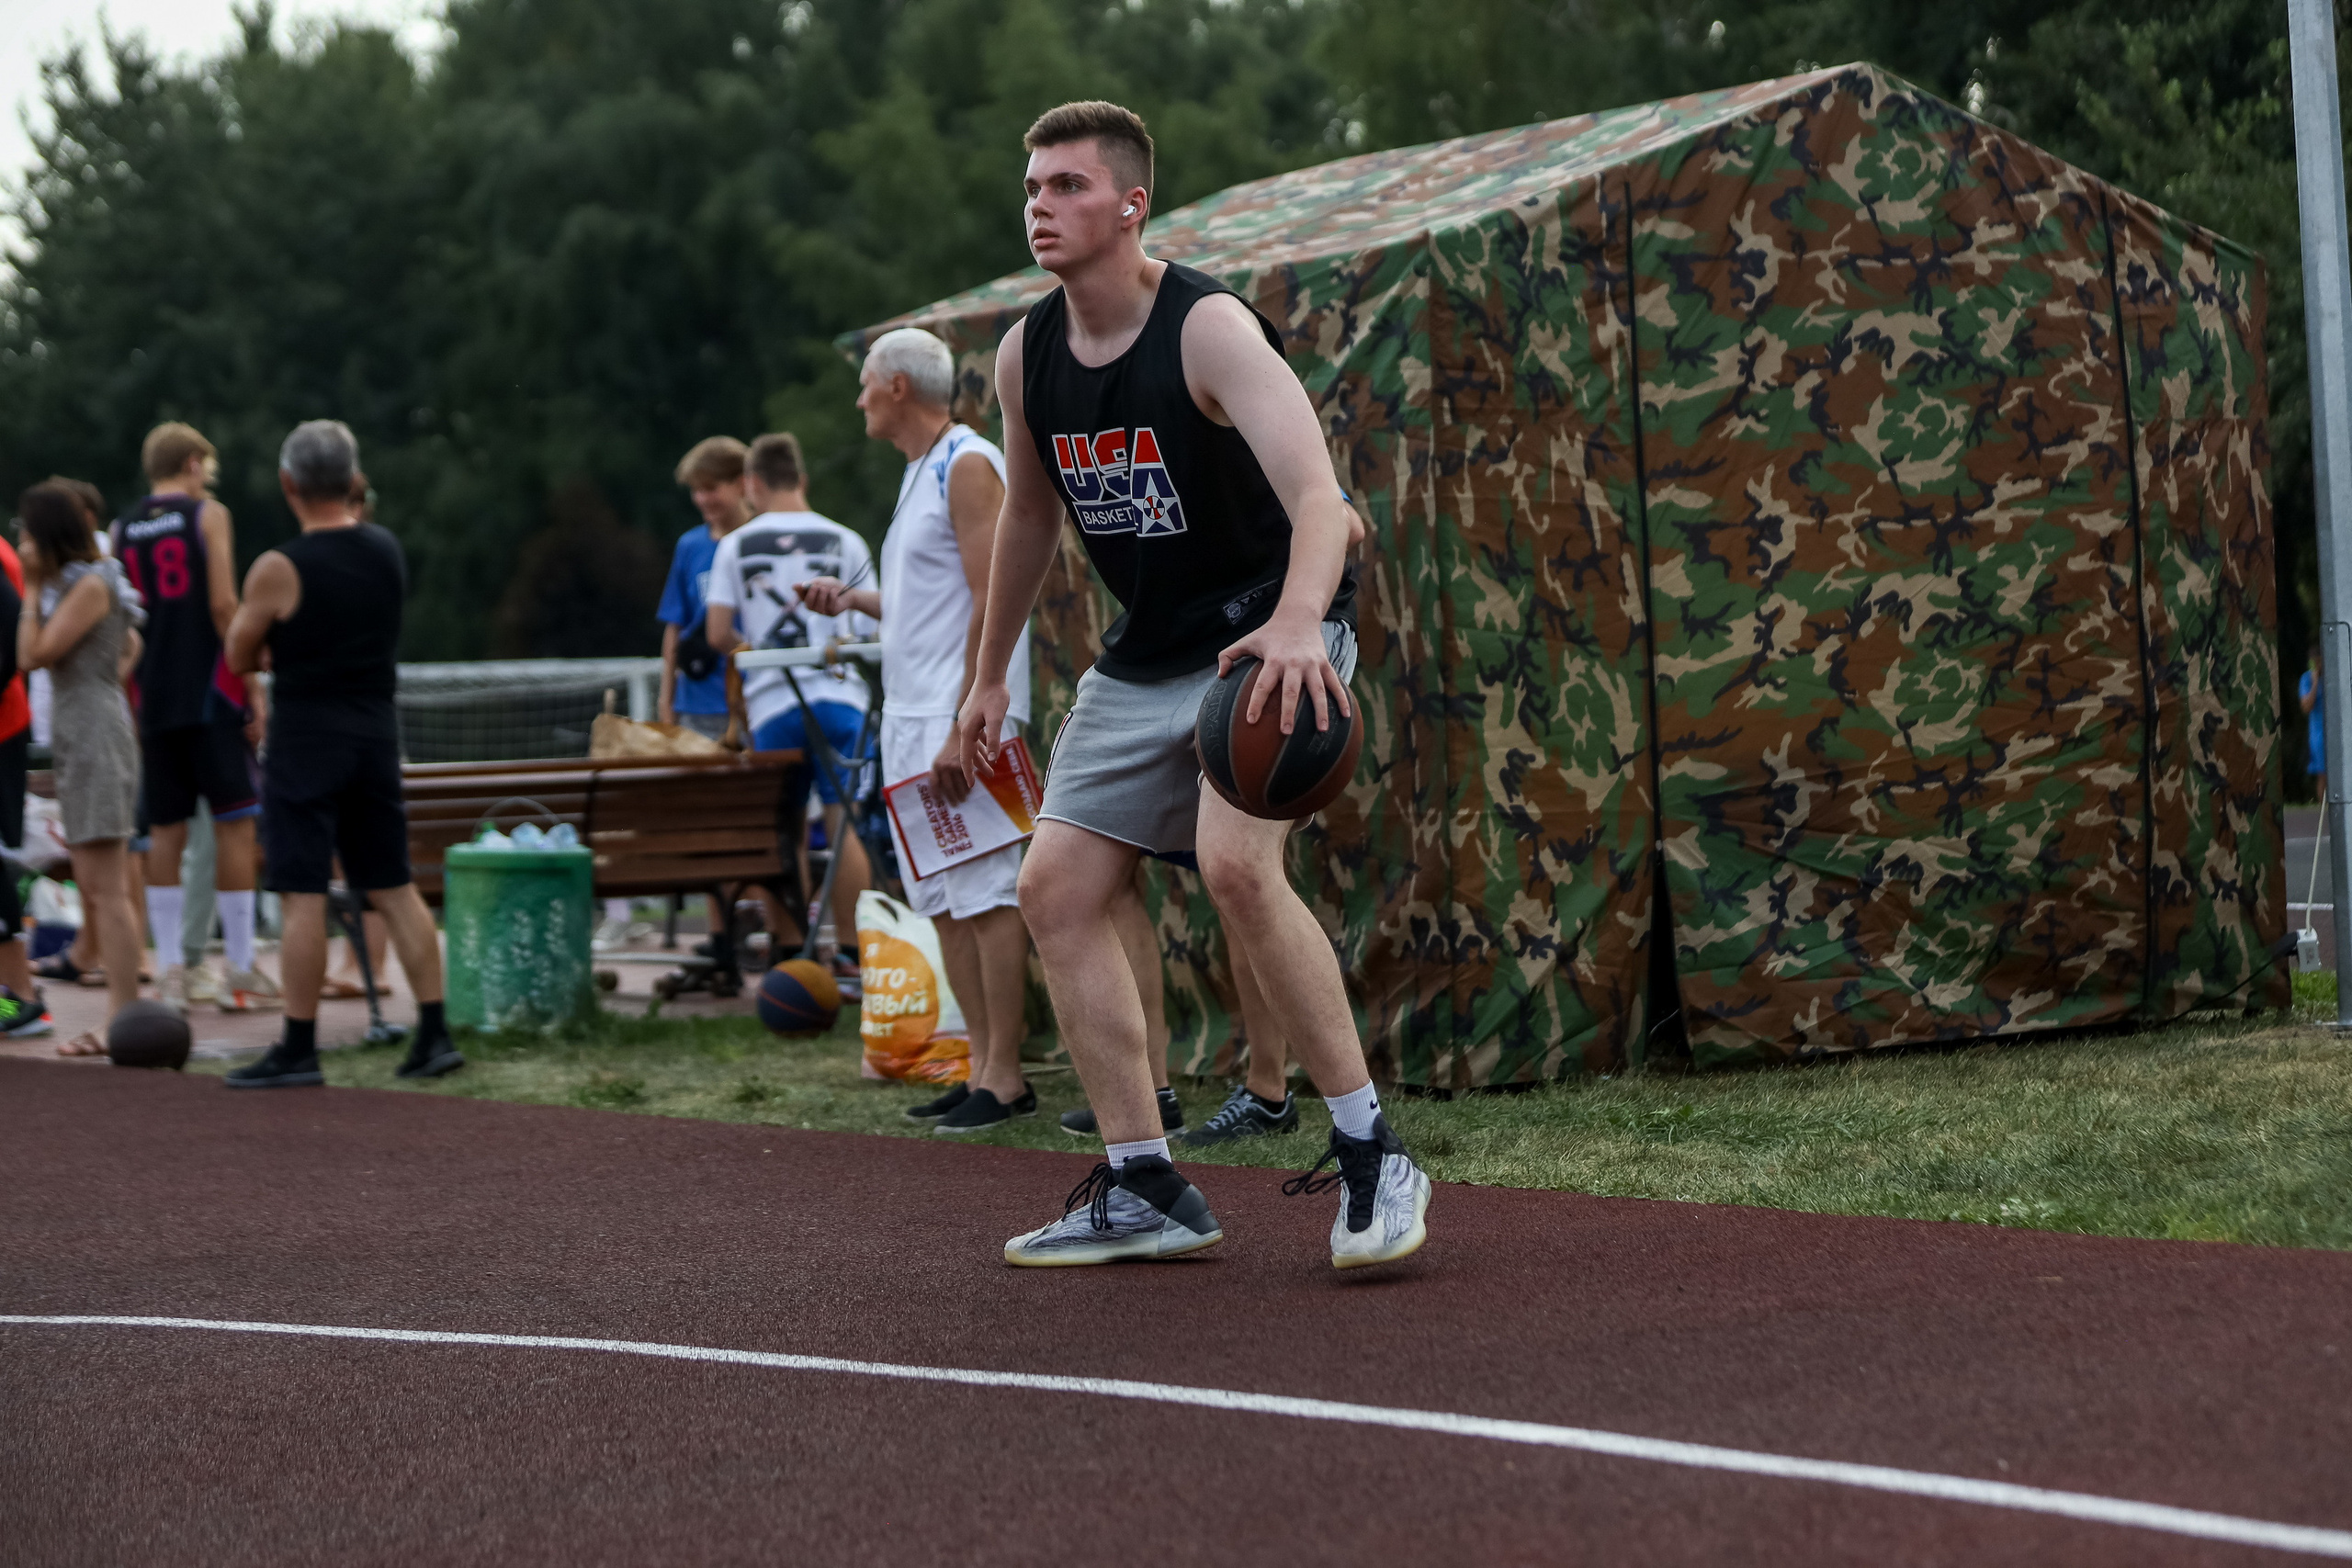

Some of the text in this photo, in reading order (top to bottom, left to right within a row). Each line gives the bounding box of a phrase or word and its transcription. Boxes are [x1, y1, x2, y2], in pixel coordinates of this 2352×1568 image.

[1051, 427, 1187, 536] USA
[123, 537, 190, 604] 18
[941, 840, 973, 858] FINAL
[954, 813, 968, 840] 2016
